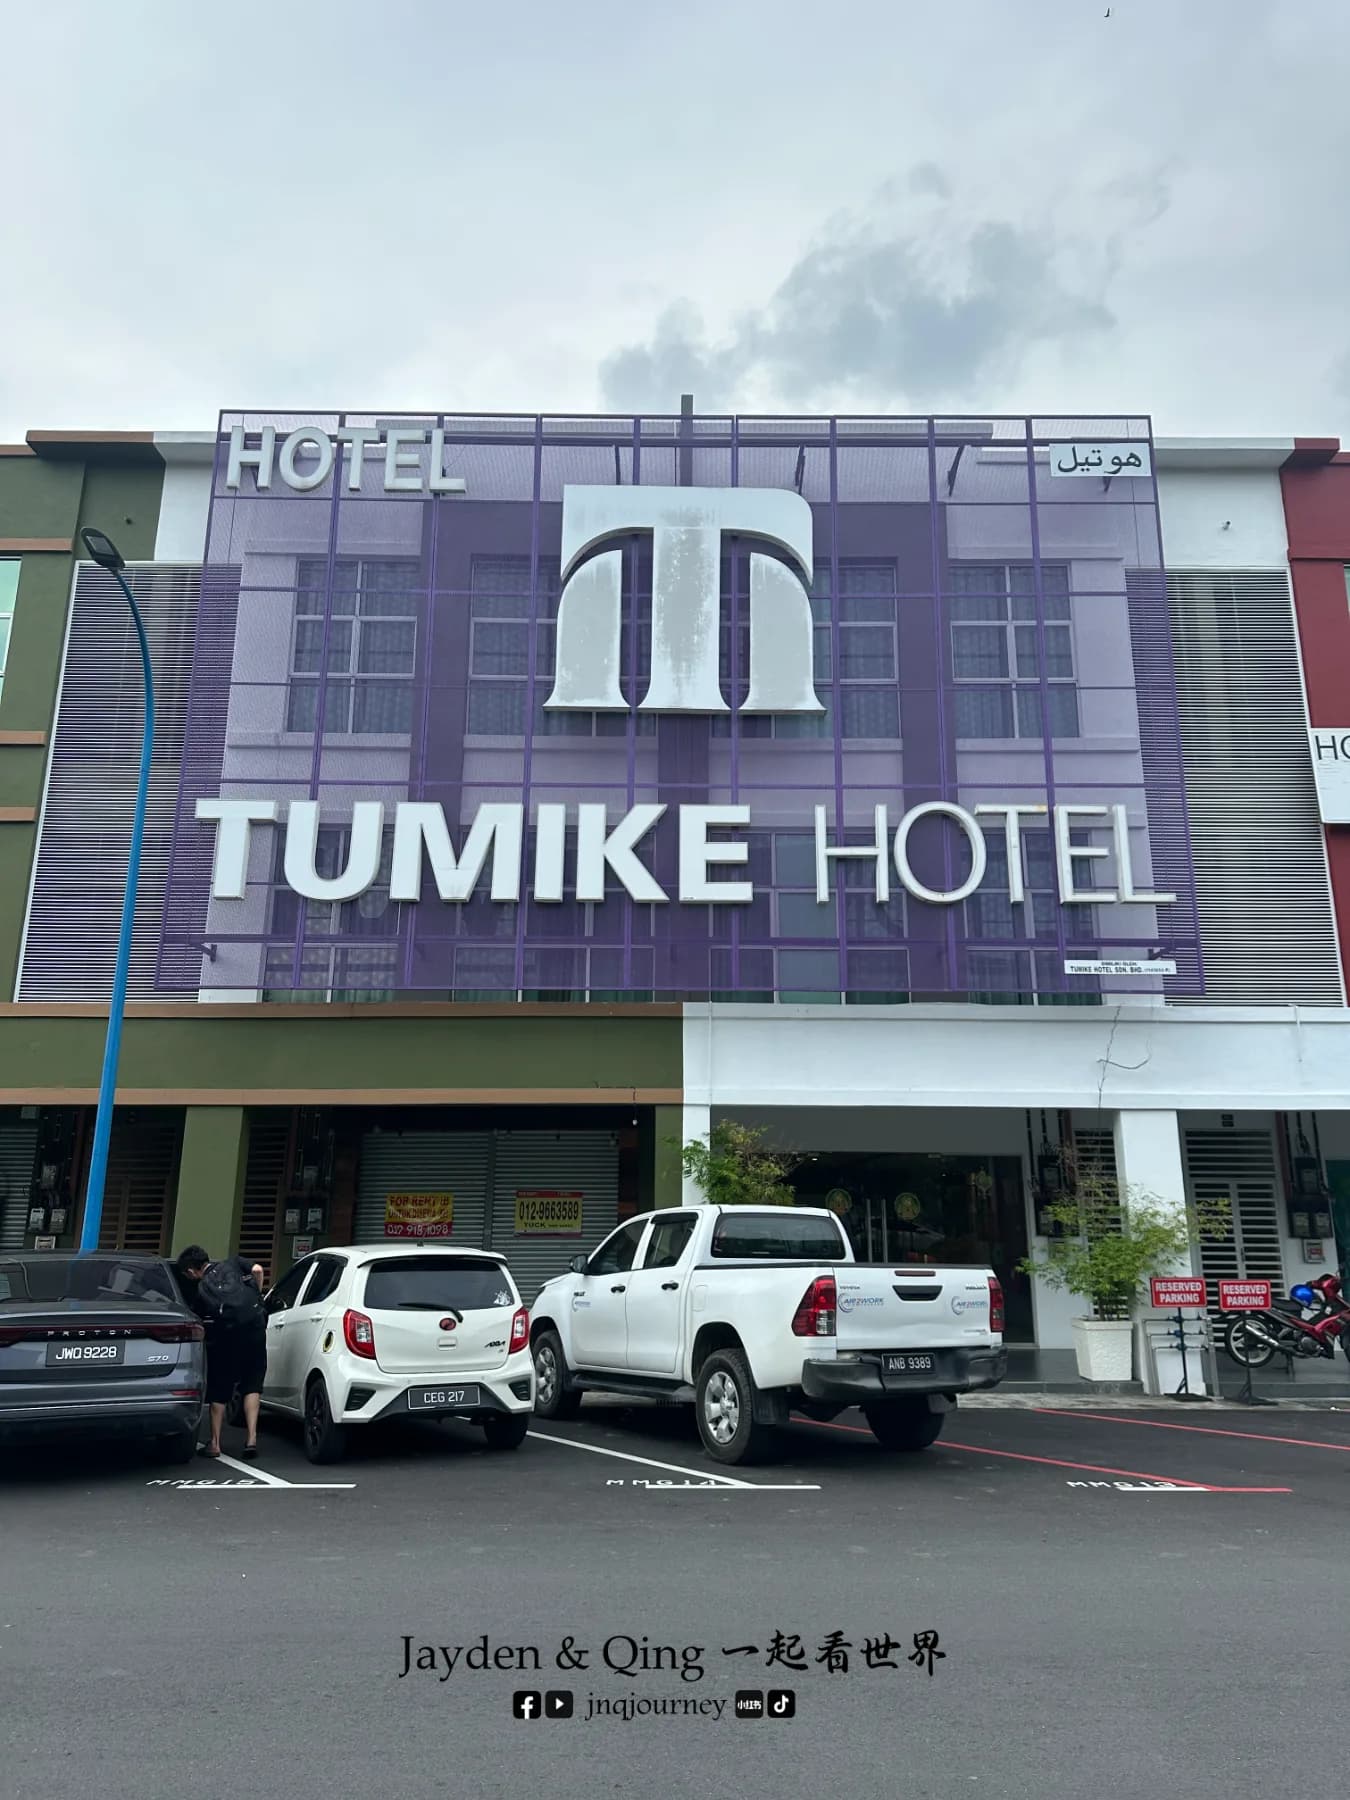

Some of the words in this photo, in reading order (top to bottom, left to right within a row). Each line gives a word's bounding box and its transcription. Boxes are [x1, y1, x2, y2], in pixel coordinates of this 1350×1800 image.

[226, 425, 466, 493] HOTEL
[1057, 445, 1142, 475] هوتيل
[195, 799, 754, 904] TUMIKE
[814, 801, 1177, 904] HOTEL
[390, 1195, 408, 1207] FOR
[518, 1201, 579, 1220] 012-9663589
[1155, 1282, 1202, 1292] RESERVED
[1223, 1285, 1267, 1295] RESERVED
[1160, 1293, 1200, 1303] PARKING
[1227, 1296, 1264, 1306] PARKING
[56, 1347, 82, 1360] JWQ
[83, 1346, 117, 1359] 9228
[888, 1357, 906, 1370] ANB
[909, 1356, 931, 1369] 9389
[423, 1391, 445, 1403] CEG
[447, 1390, 465, 1402] 217
